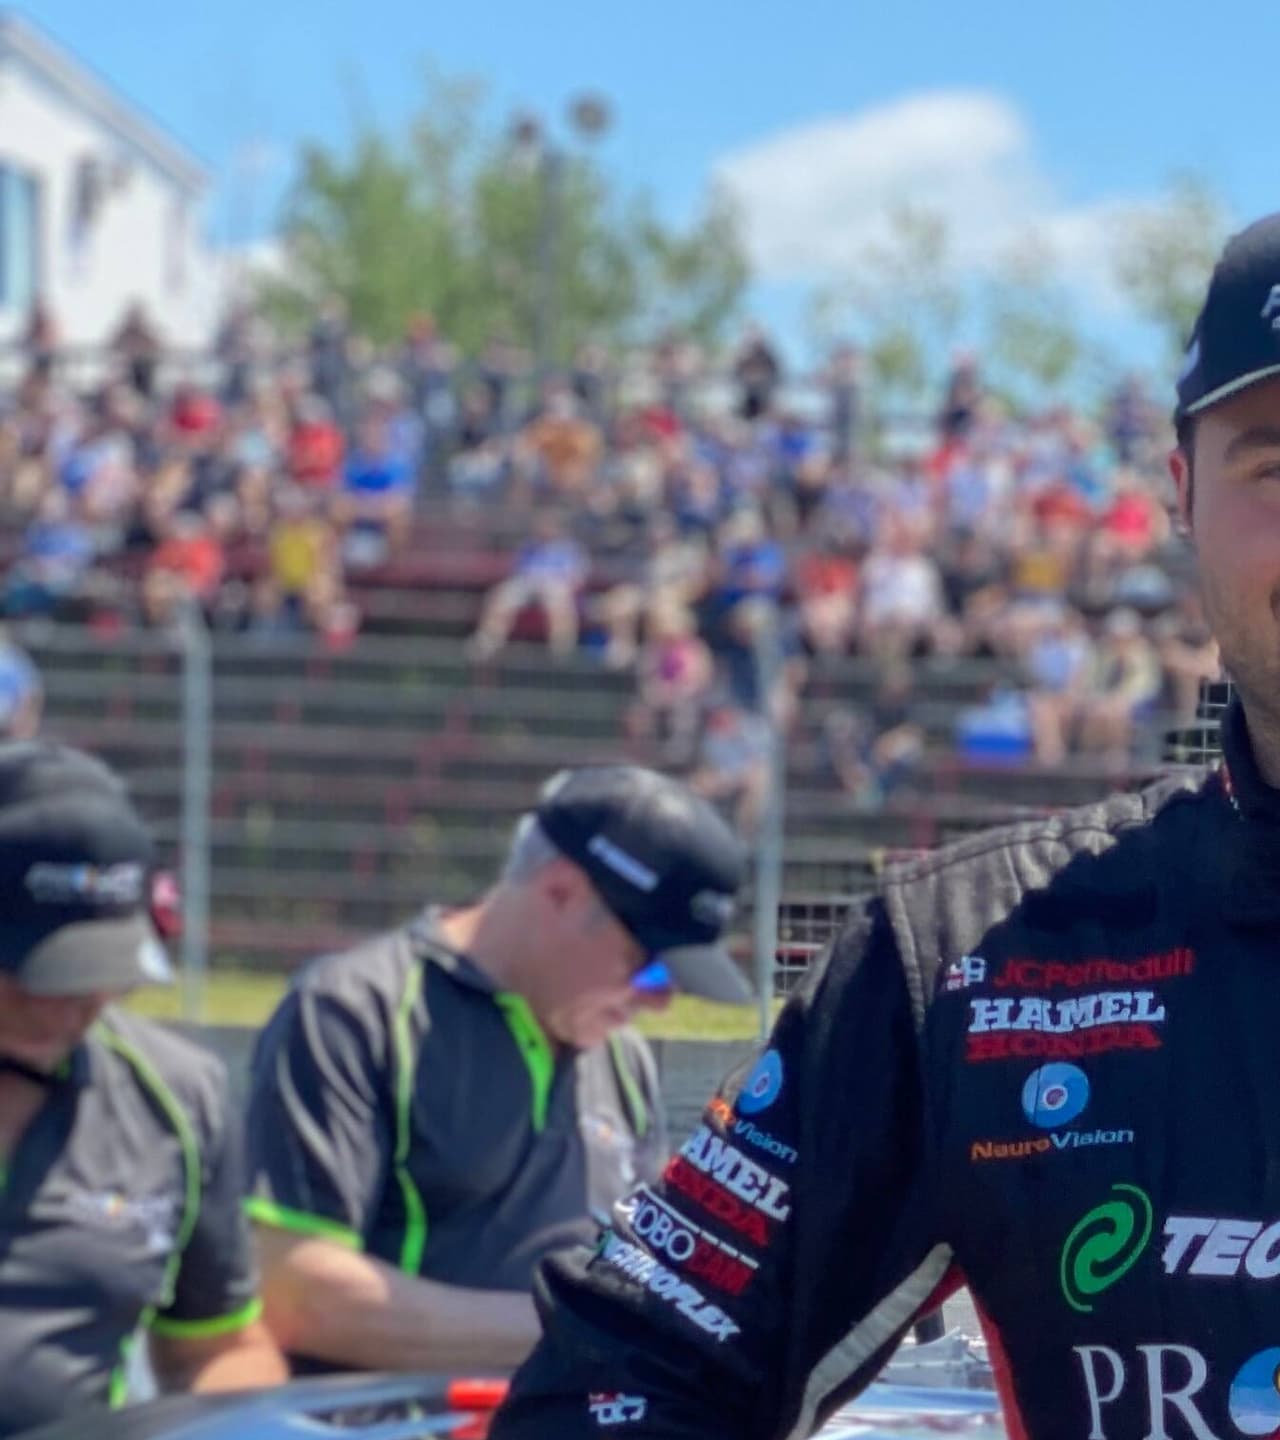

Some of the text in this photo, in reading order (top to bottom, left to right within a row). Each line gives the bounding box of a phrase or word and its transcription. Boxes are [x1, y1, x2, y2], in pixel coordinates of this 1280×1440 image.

[968, 991, 1166, 1033] HAMEL
[965, 1023, 1164, 1064] HONDA
[970, 1127, 1134, 1162] NeuroVision
[679, 1126, 792, 1221] AMEL
